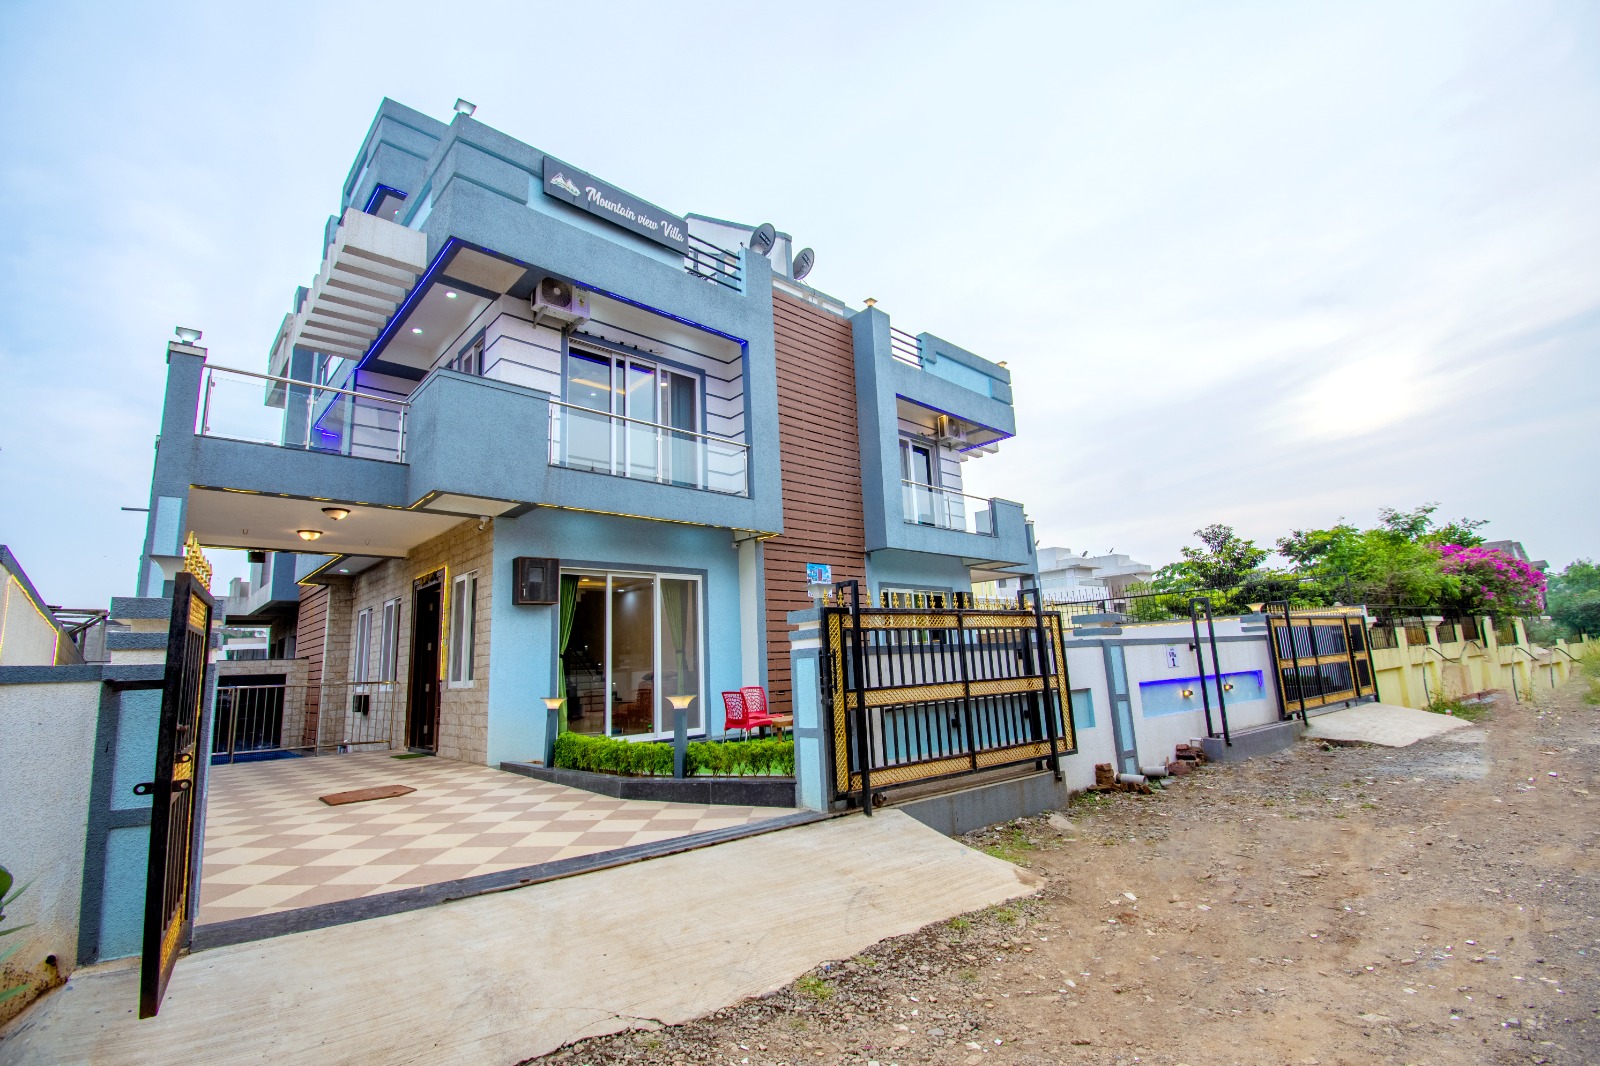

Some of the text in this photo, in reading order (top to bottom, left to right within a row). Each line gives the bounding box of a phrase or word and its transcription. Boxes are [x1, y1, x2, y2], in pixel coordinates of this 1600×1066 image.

[586, 186, 685, 242] Mountain view Villa
